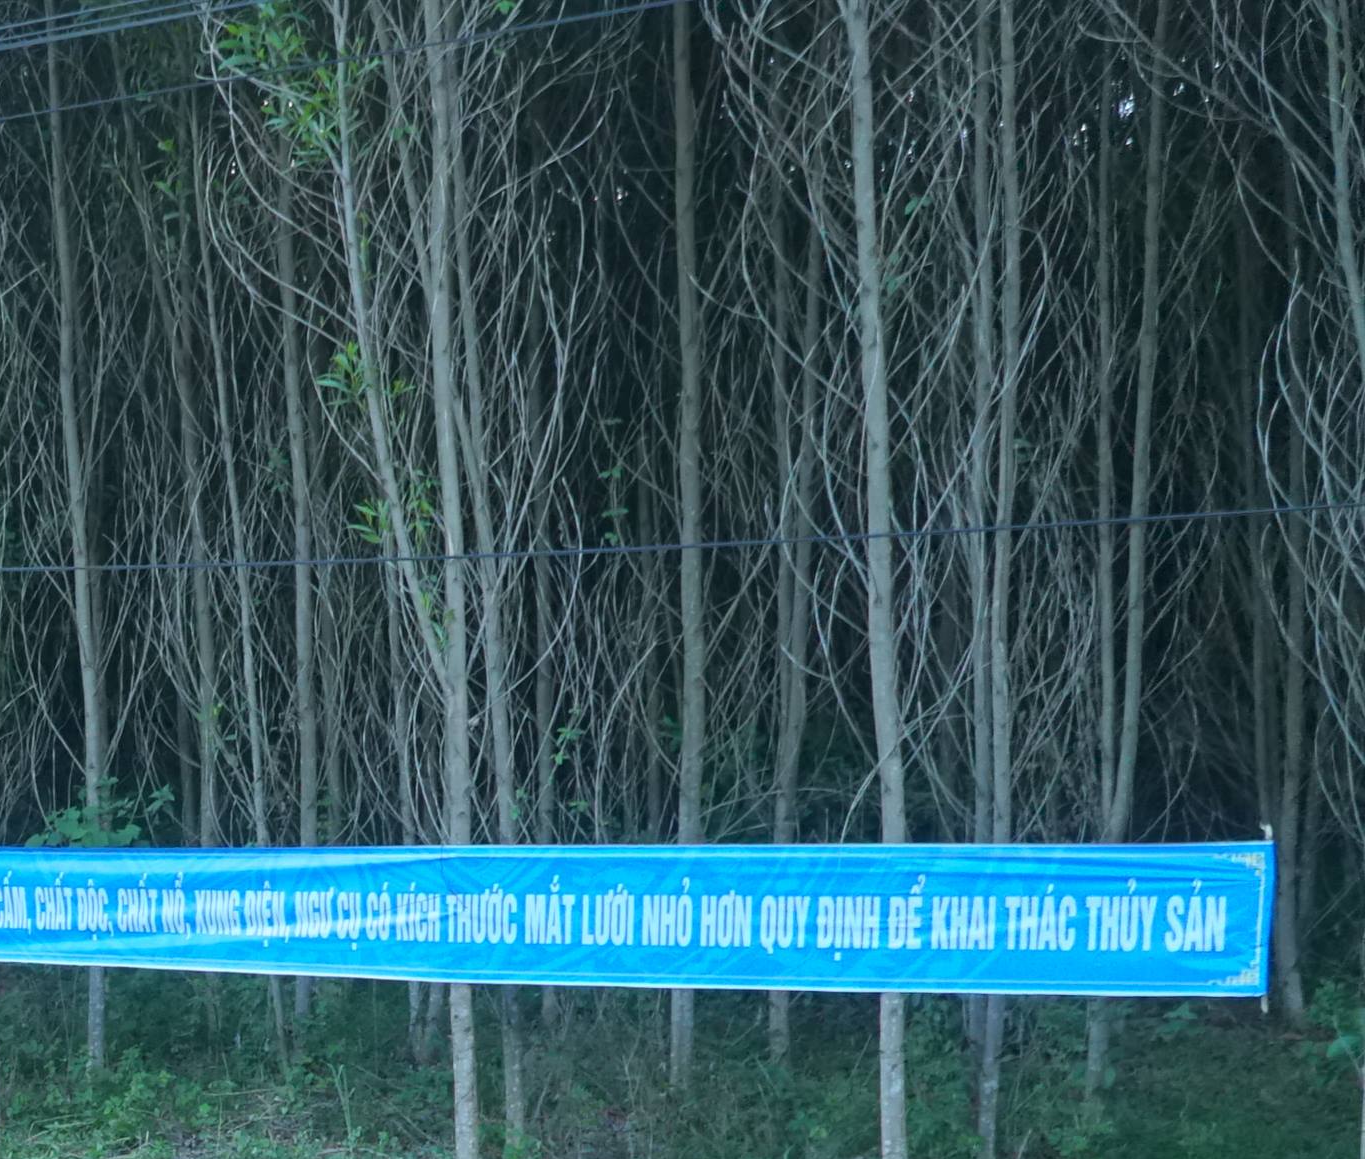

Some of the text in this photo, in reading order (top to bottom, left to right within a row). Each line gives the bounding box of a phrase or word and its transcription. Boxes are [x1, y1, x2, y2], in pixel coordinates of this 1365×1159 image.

[34, 872, 73, 931] CHẤT
[76, 878, 115, 941] ĐỘC,
[117, 873, 159, 933] CHẤT
[161, 871, 192, 940] NỔ,
[194, 889, 241, 936] XUNG
[244, 881, 291, 948] ĐIỆN,
[294, 886, 336, 939] NGƯ
[336, 891, 362, 950] CỤ
[366, 881, 391, 942] CÓ
[396, 882, 441, 943] KÍCH
[447, 883, 518, 944] THƯỚC
[525, 875, 576, 945] MẮT
[581, 884, 635, 946] LƯỚI
[642, 877, 693, 947] NHỎ
[700, 889, 752, 947] HƠN
[760, 895, 811, 954] QUY
[816, 895, 880, 961] ĐỊNH
[887, 874, 926, 949] ĐỂ
[931, 895, 997, 950] KHAI
[1005, 884, 1077, 951] THÁC
[1086, 878, 1158, 951] THỦY
[1165, 879, 1227, 952] SẢN
